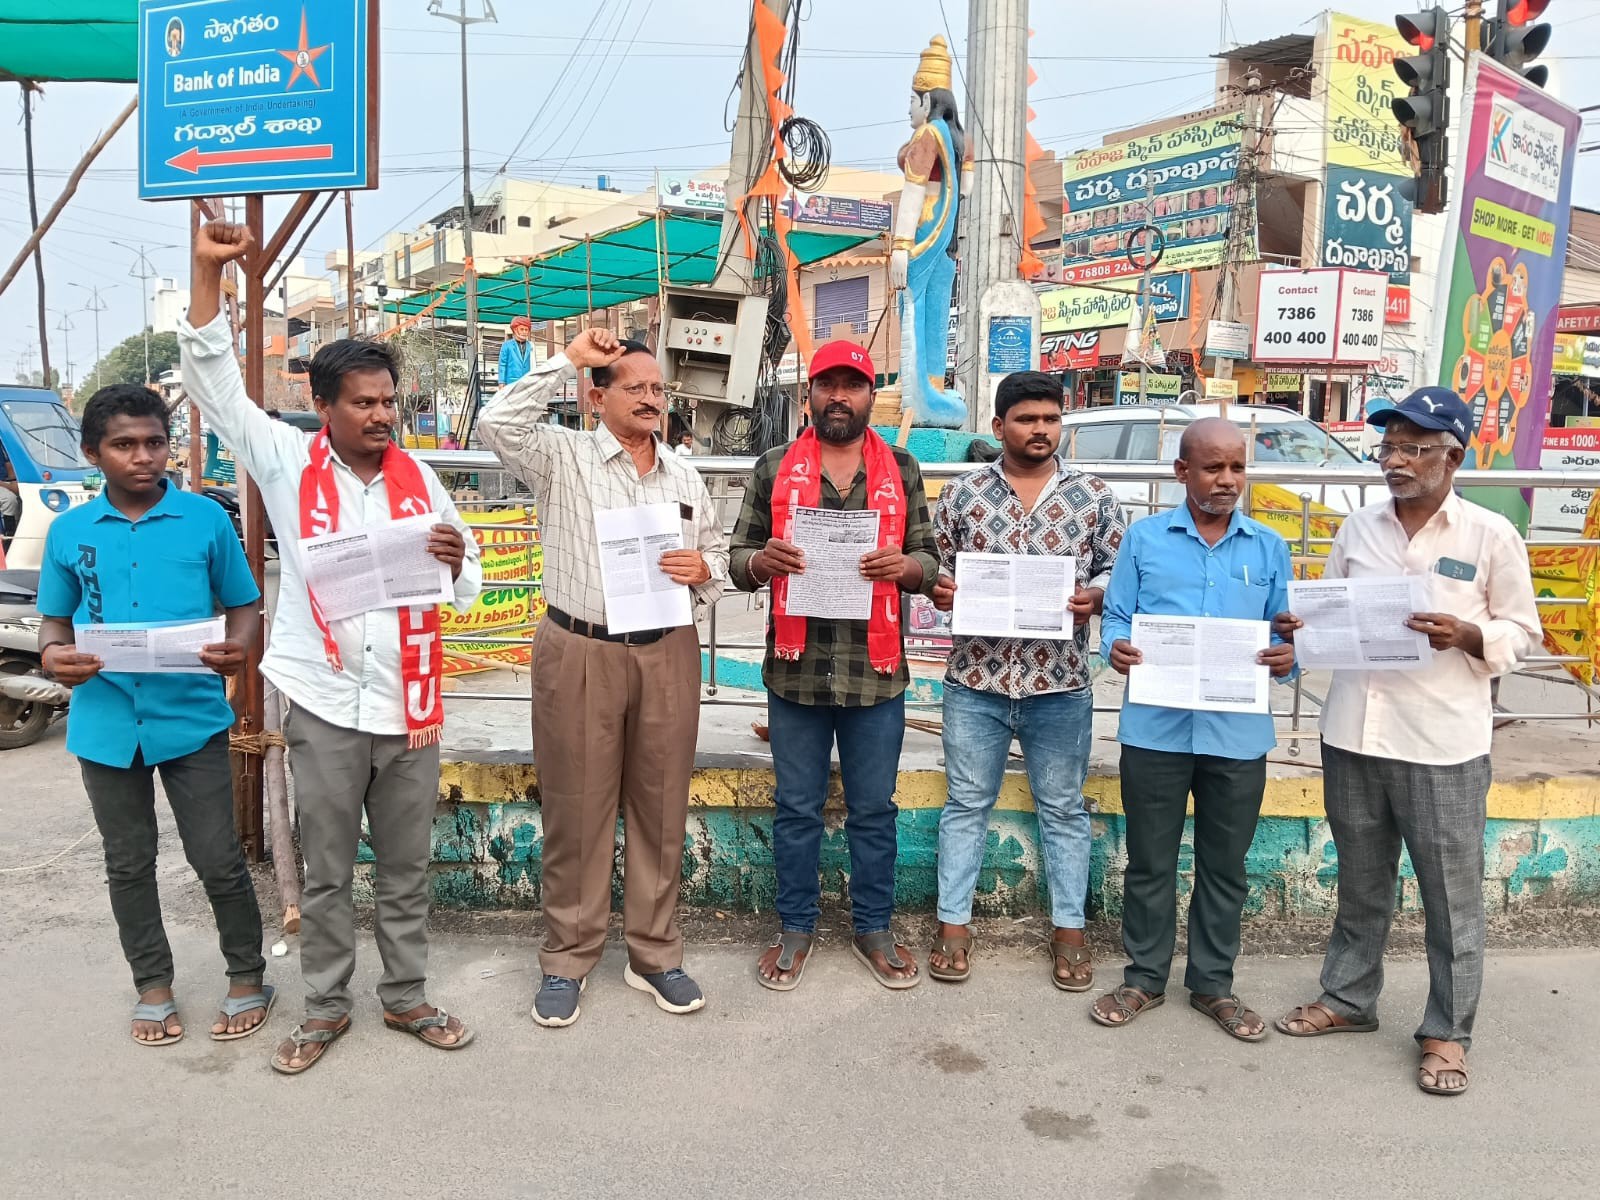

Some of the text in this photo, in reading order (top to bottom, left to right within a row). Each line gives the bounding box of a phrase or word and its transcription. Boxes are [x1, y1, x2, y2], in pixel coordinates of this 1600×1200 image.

[204, 13, 279, 43] స్వాగతం
[173, 63, 280, 93] Bank of India
[190, 105, 232, 118] Government
[235, 102, 243, 113] of
[246, 101, 264, 113] India
[267, 98, 316, 111] Undertaking)
[174, 115, 322, 144] గద్వాల్ శాఖ
[1127, 134, 1163, 162] స్కిన్
[1075, 175, 1122, 202] చర్మ
[1335, 177, 1403, 245] చర్మ
[1473, 208, 1496, 227] SHOP
[1497, 216, 1518, 235] MORE
[1521, 225, 1536, 242] GET
[1325, 237, 1409, 272] దవాఖాన
[1079, 265, 1111, 279] 76808
[1278, 286, 1318, 295] Contact
[1353, 286, 1376, 297] Contact
[1058, 297, 1081, 324] స్కిన్
[1277, 307, 1316, 320] 7386
[1351, 308, 1374, 322] 7386
[1040, 330, 1099, 354] STING
[1263, 331, 1326, 344] 400 400
[1342, 333, 1378, 347] 400 400
[1542, 434, 1599, 448] FINE RS 1000/-
